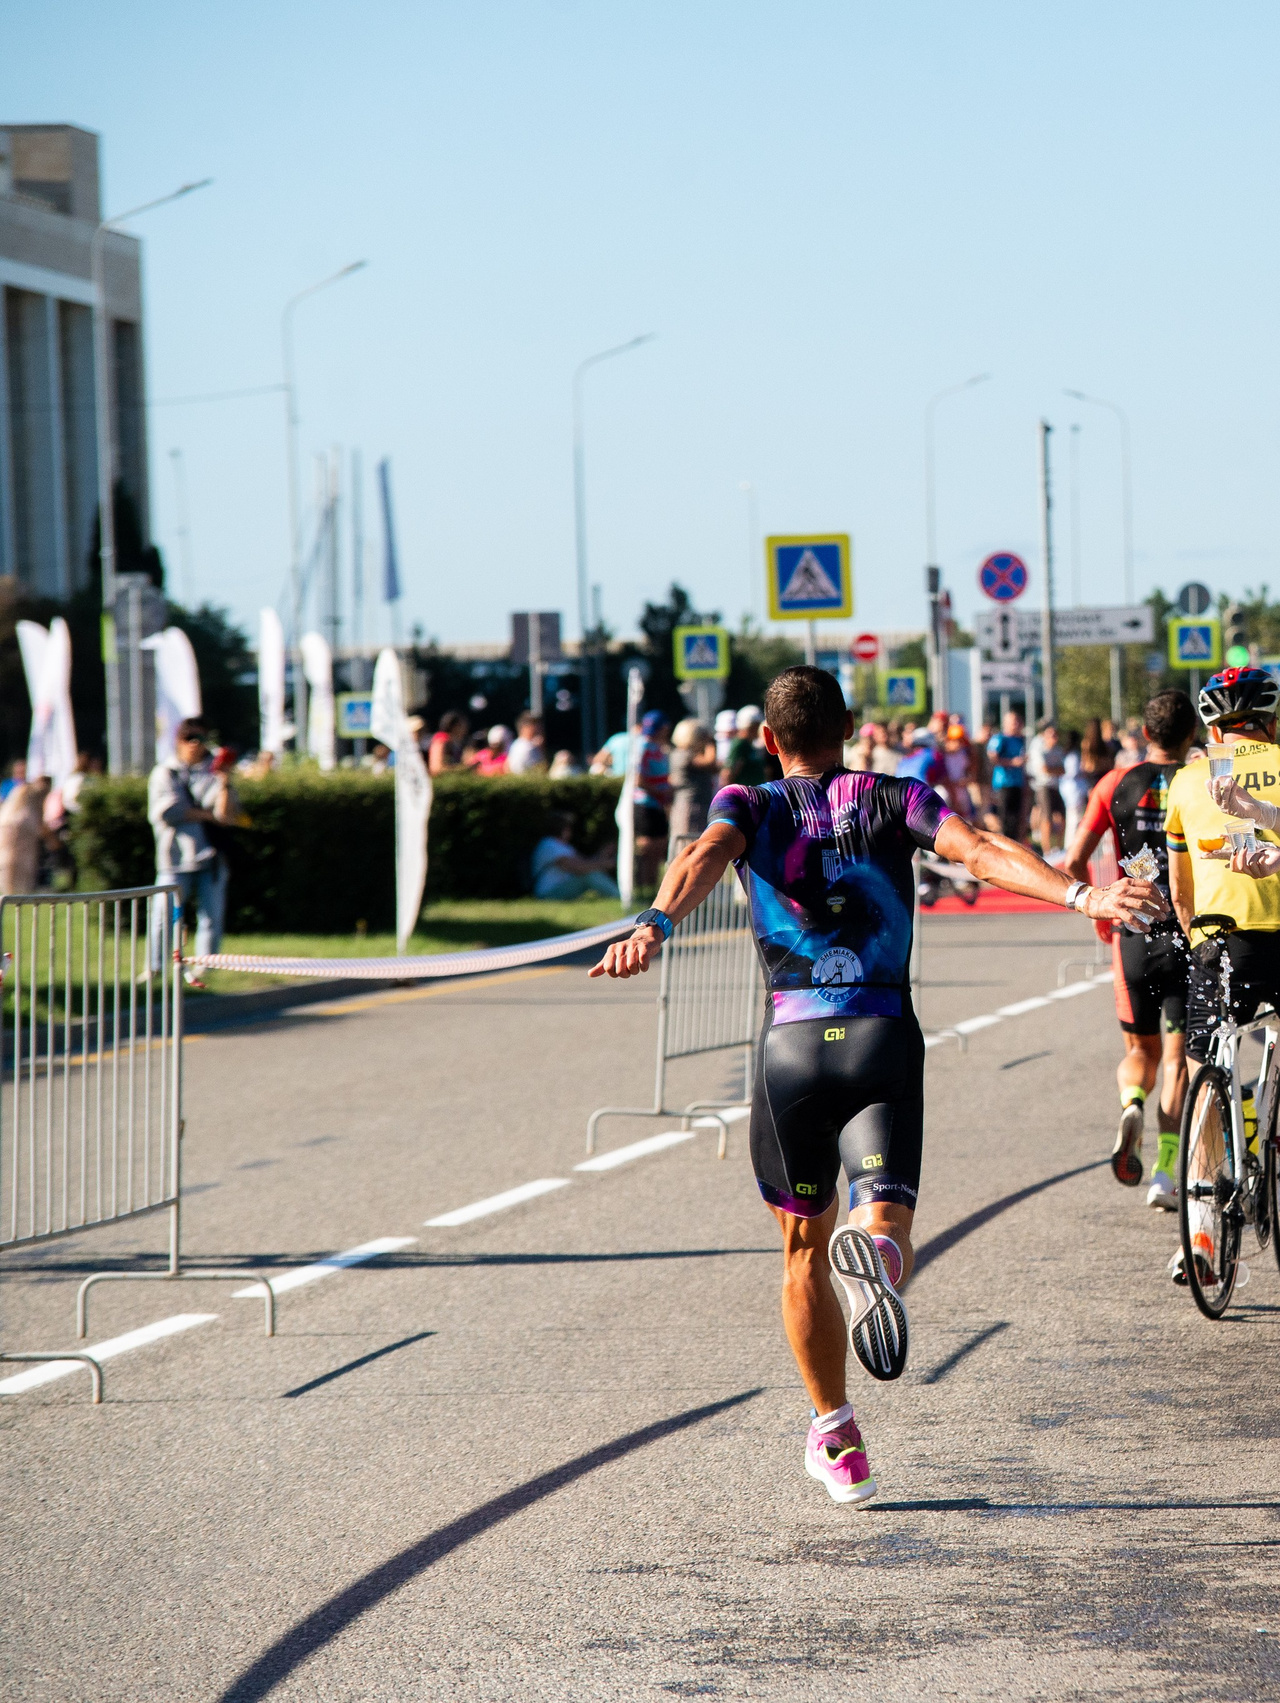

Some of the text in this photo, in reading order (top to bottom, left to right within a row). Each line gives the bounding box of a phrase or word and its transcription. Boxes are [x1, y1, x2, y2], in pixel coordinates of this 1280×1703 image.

[793, 800, 858, 822] SHEMIAKIN
[800, 817, 857, 839] ALEKSEY
[820, 949, 857, 963] SHEMIAKIN
[824, 992, 850, 1002] TEAM
